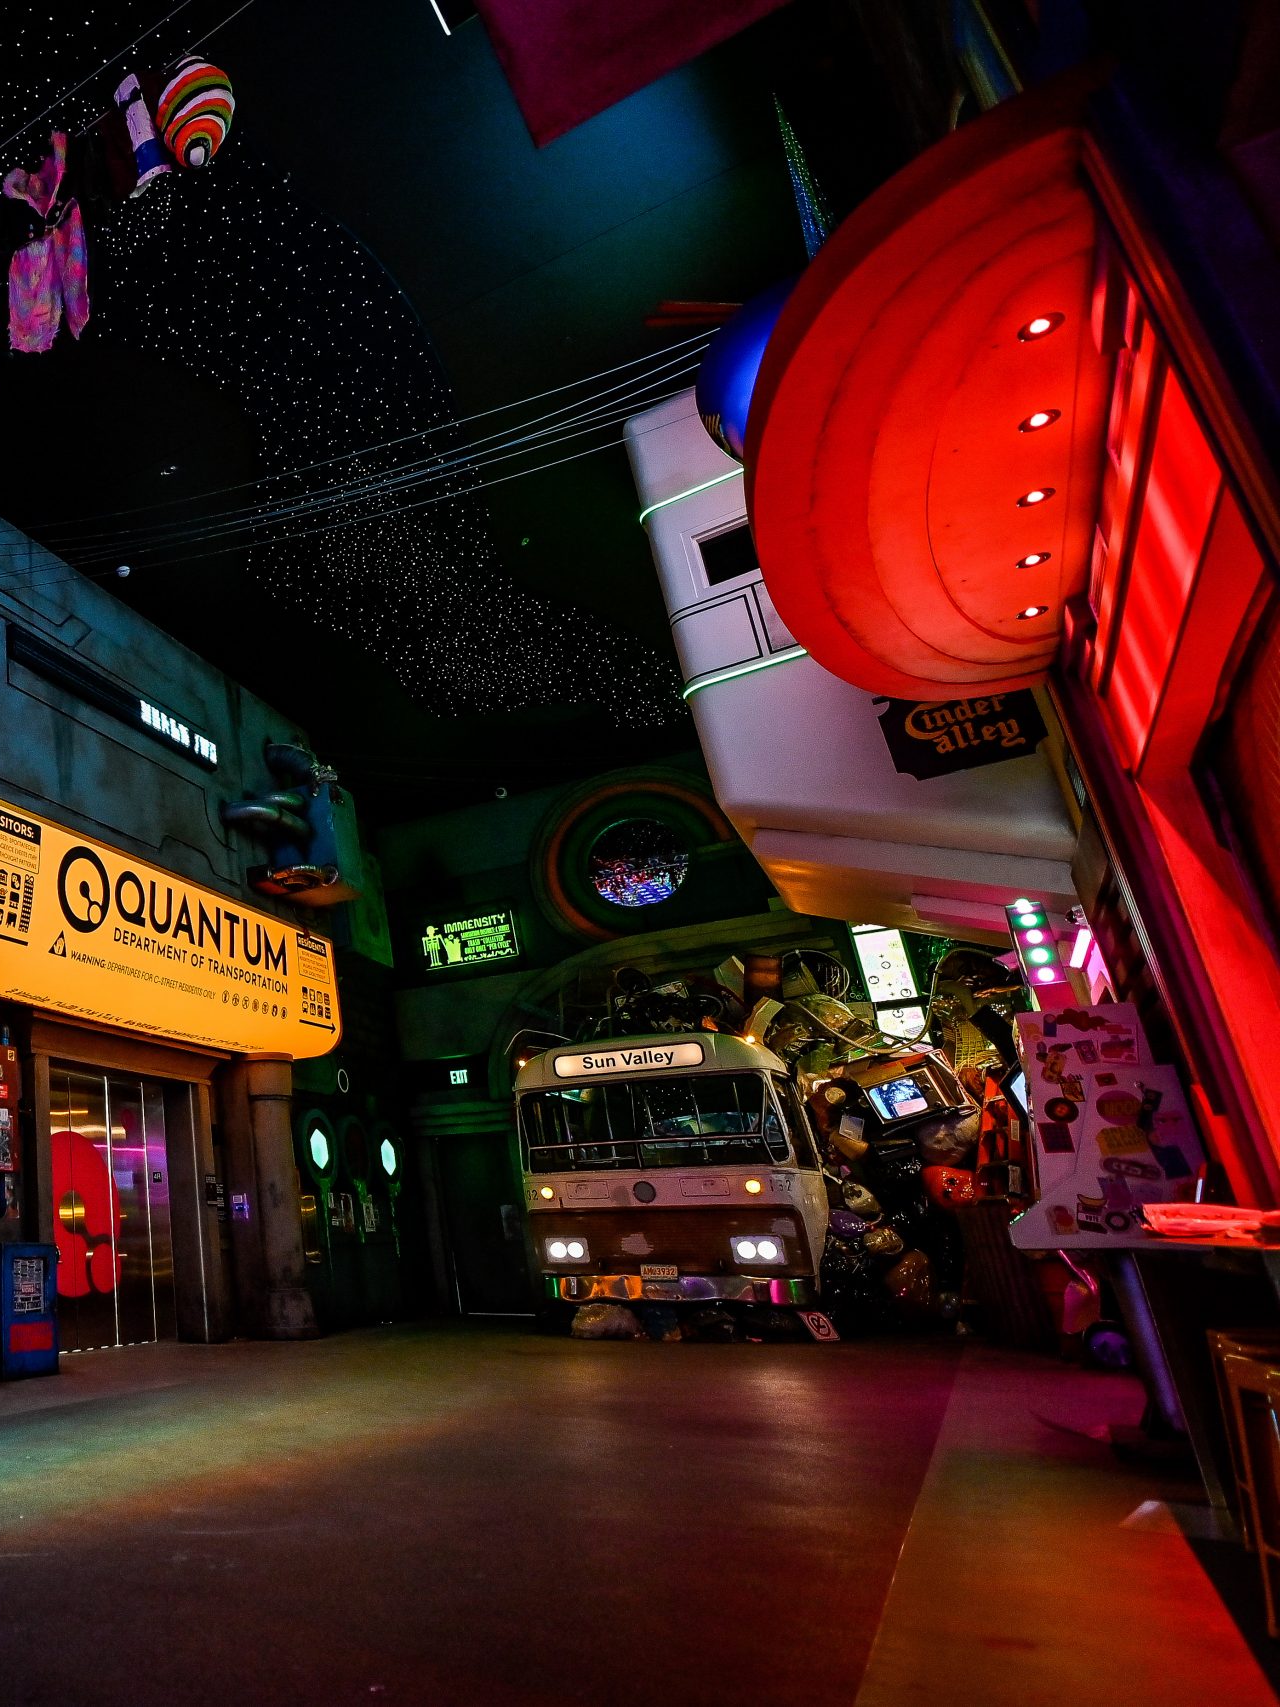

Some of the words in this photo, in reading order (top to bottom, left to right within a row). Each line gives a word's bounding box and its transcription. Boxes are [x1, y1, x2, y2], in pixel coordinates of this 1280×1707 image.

[904, 695, 1007, 740] Cinder
[933, 718, 1026, 755] alley
[115, 870, 287, 976] QUANTUM
[443, 912, 506, 934] IMMENSITY
[71, 950, 107, 968] WARNING:
[107, 961, 141, 979] DEPARTURES
[141, 972, 153, 983] FOR
[154, 975, 178, 990] C-STREET
[179, 982, 203, 996] RESIDENTS
[203, 989, 216, 1000] ONLY
[113, 927, 187, 964] DEPARTMENT
[191, 953, 204, 969] OF
[208, 958, 288, 995] TRANSPORTATION
[449, 1069, 468, 1085] EXIT
[583, 1056, 616, 1069] Sun
[620, 1051, 674, 1065] Valley
